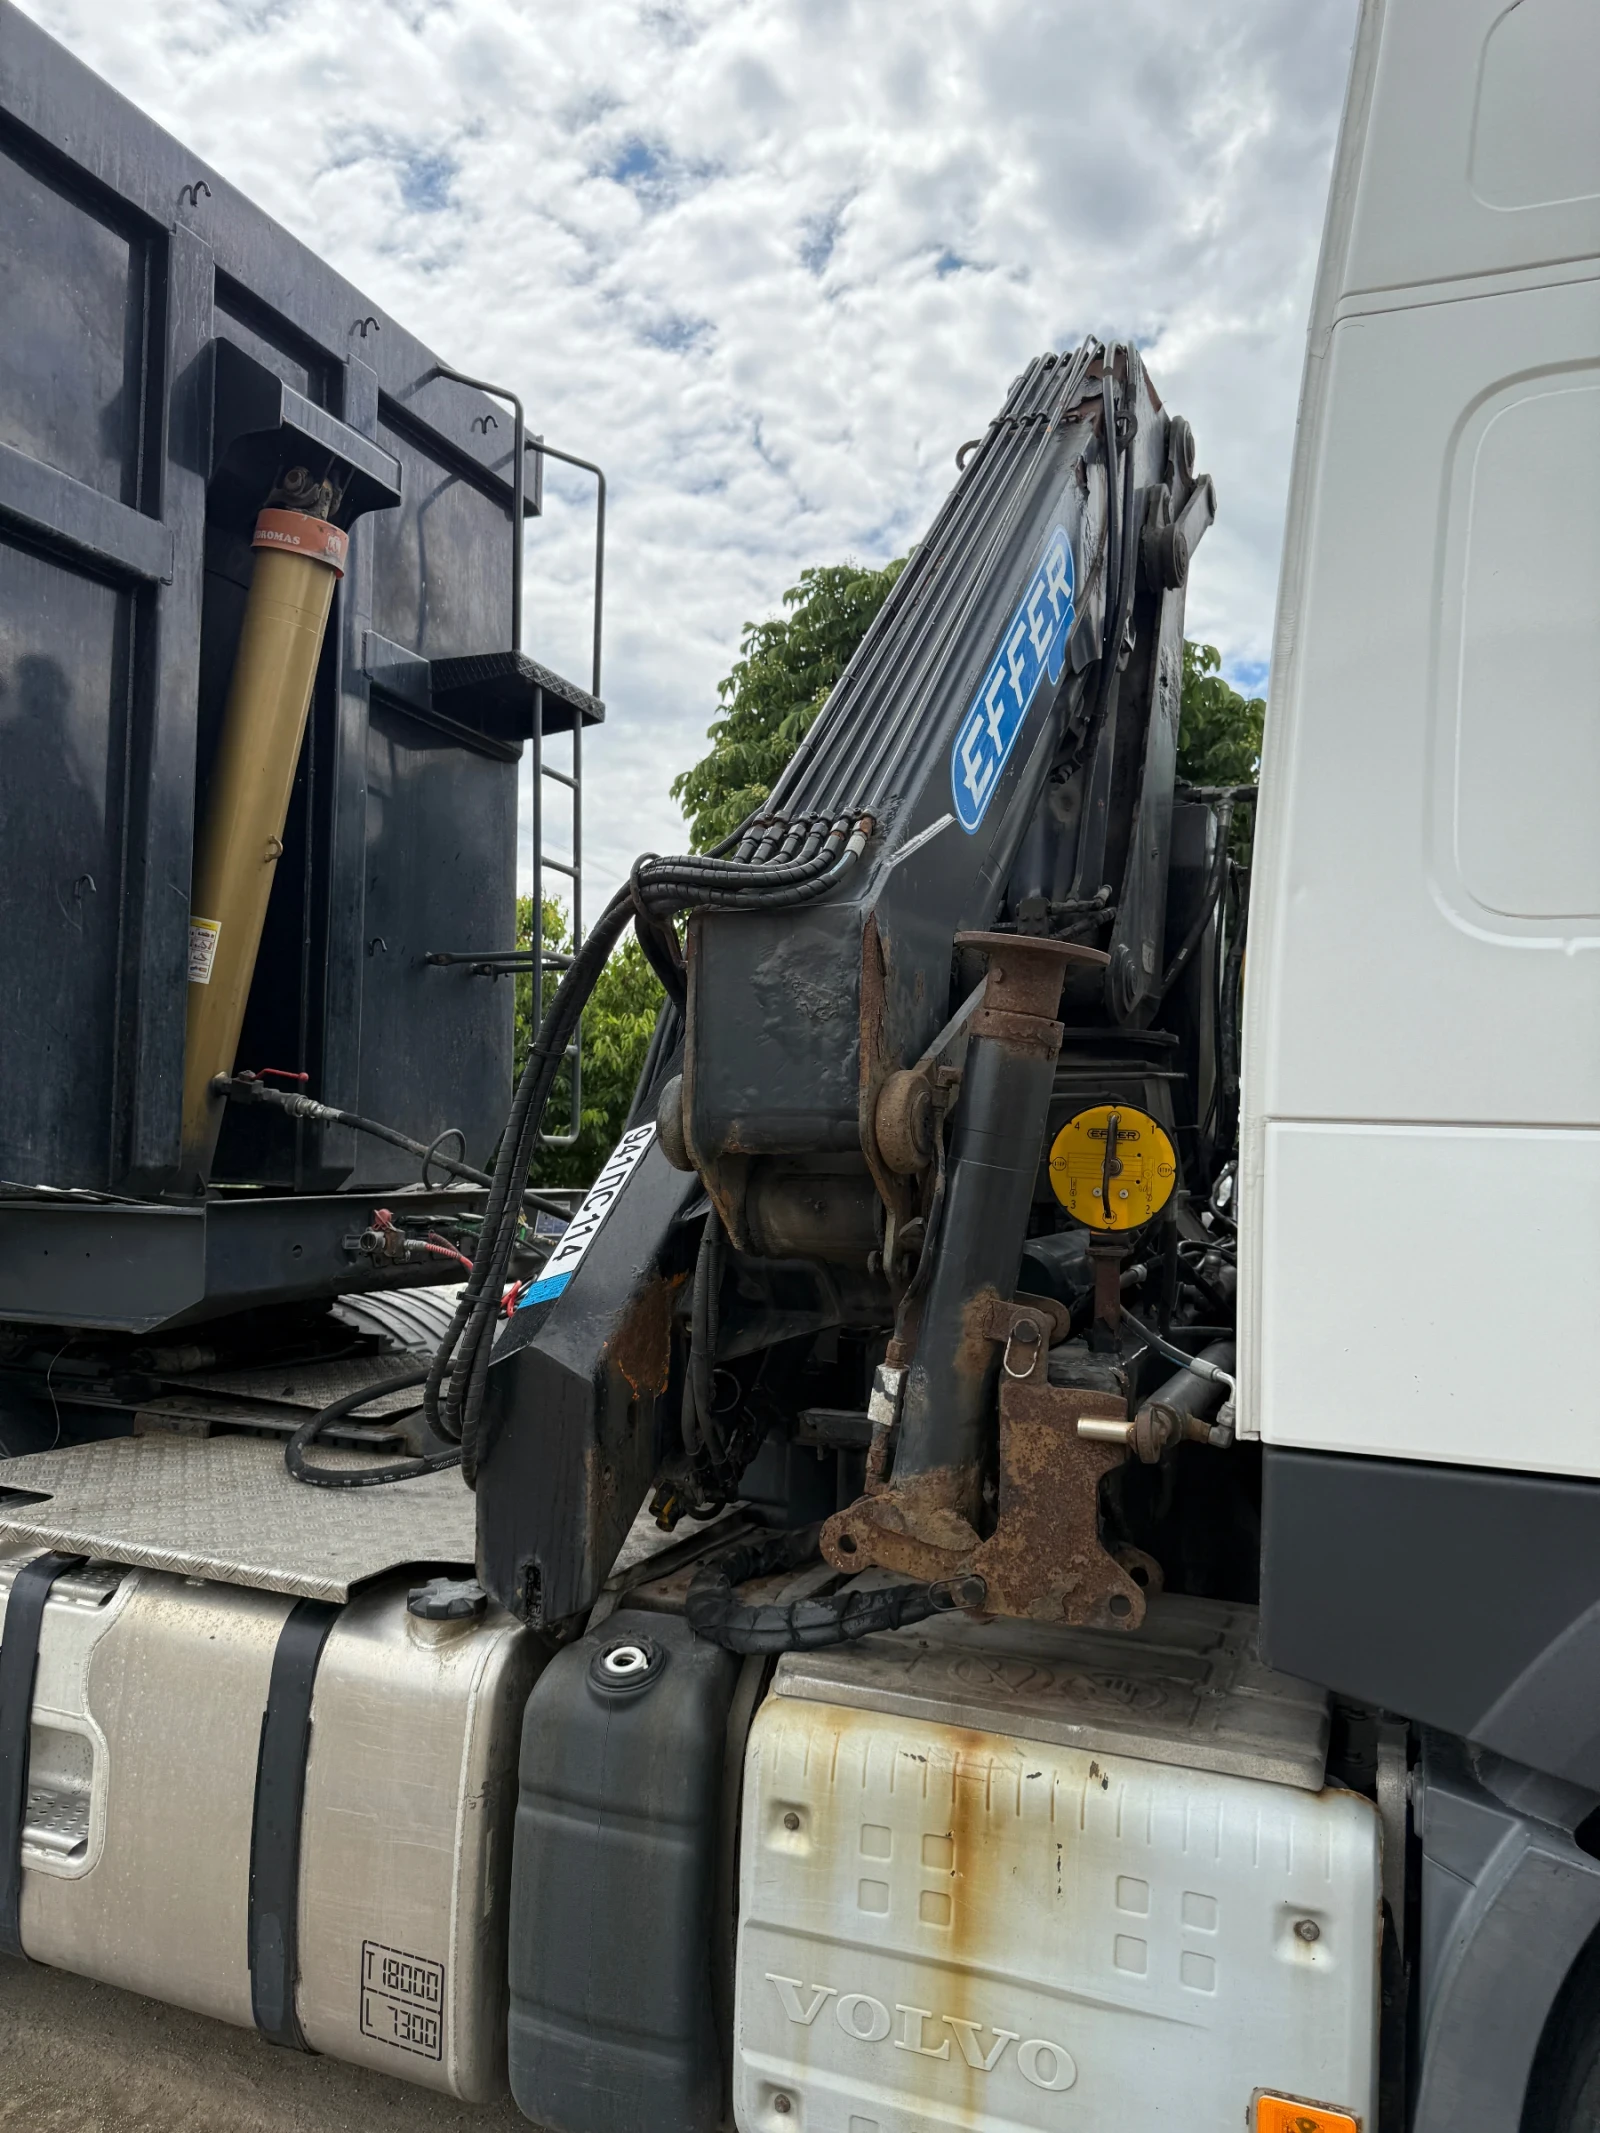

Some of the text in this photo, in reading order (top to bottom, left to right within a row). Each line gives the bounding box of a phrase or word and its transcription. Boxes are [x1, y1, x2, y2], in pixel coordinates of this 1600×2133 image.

[961, 543, 1070, 809] EFFER
[1074, 1122, 1080, 1131] 4
[1090, 1130, 1136, 1139] EFER
[1070, 1200, 1076, 1209] 3
[1145, 1205, 1151, 1214] 2
[366, 1950, 438, 2002] T 18000
[366, 1998, 437, 2049] L 7300
[765, 1973, 1077, 2091] VOLVO
